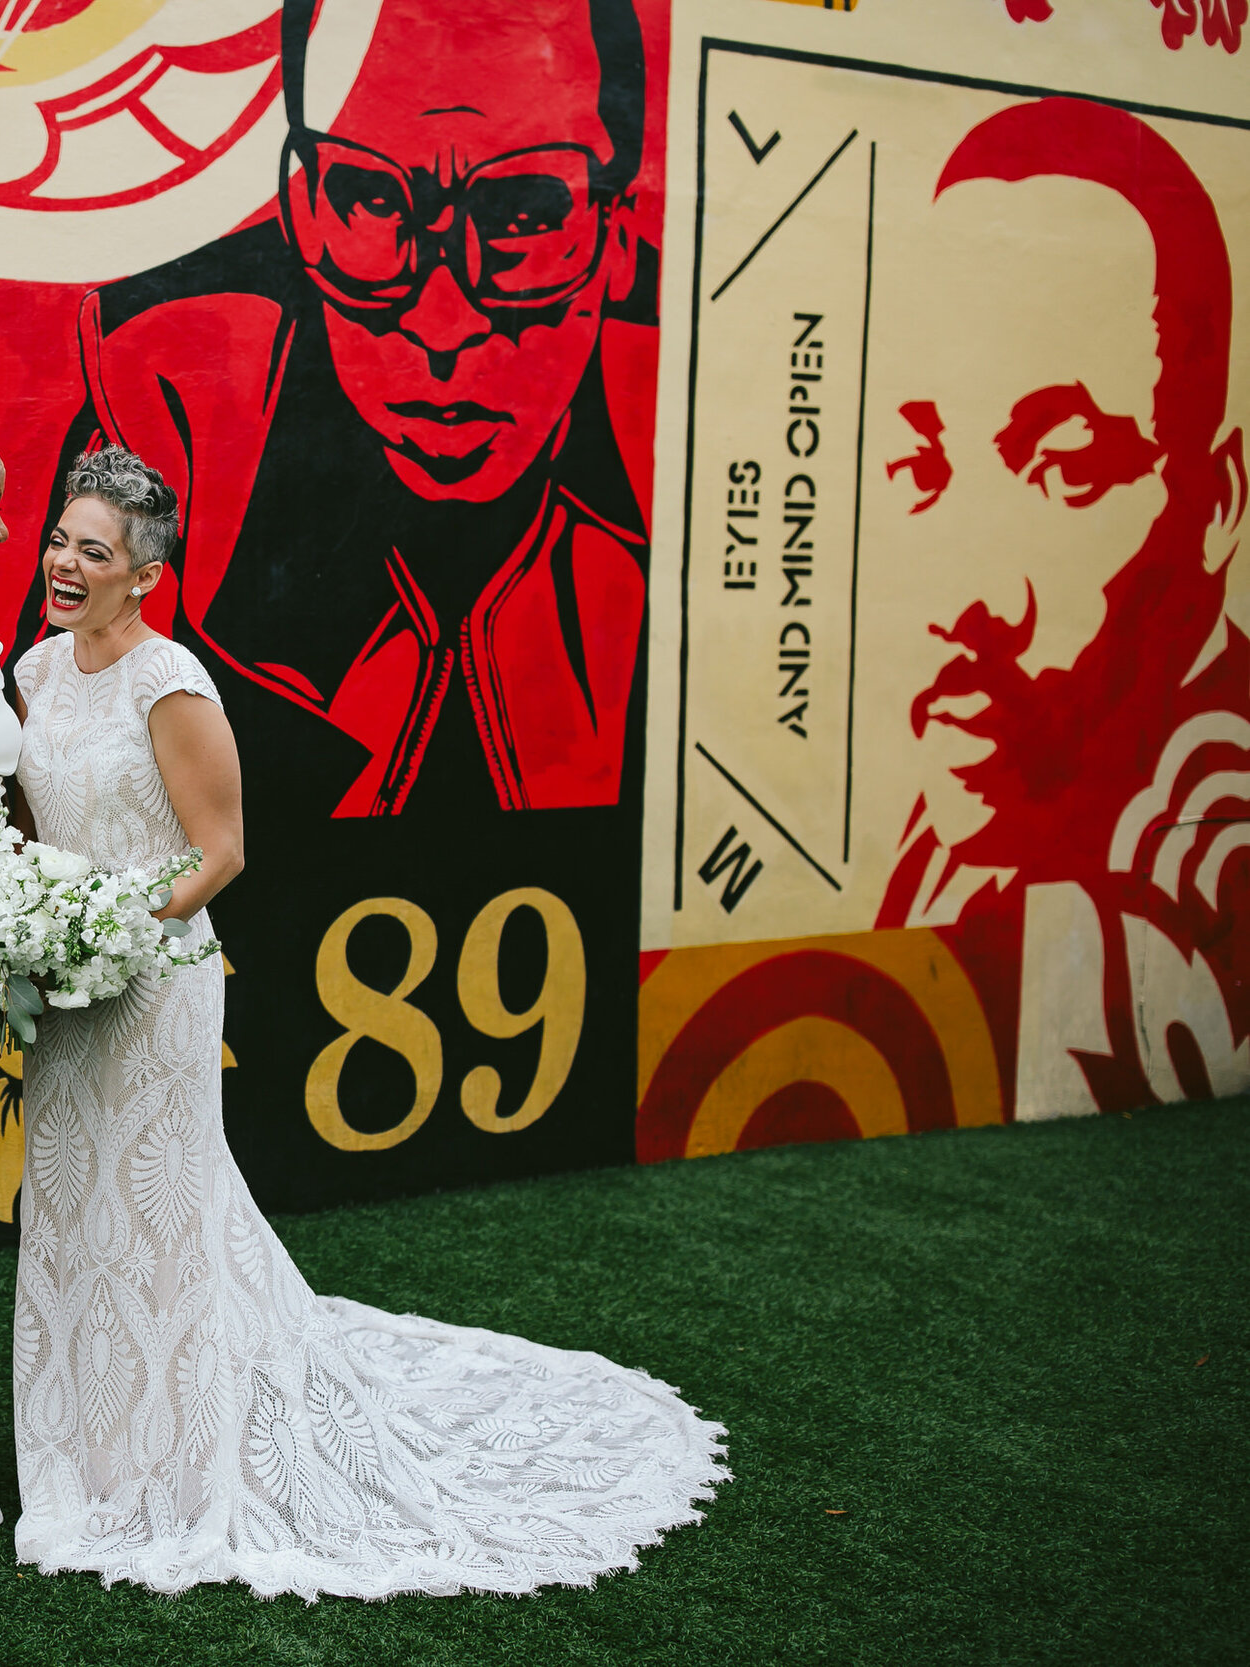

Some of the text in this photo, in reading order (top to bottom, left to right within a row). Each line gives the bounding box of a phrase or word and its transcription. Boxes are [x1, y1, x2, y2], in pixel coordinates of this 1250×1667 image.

[722, 459, 762, 592] EYES
[775, 311, 825, 740] AND MIND OPEN
[303, 885, 588, 1153] 89
